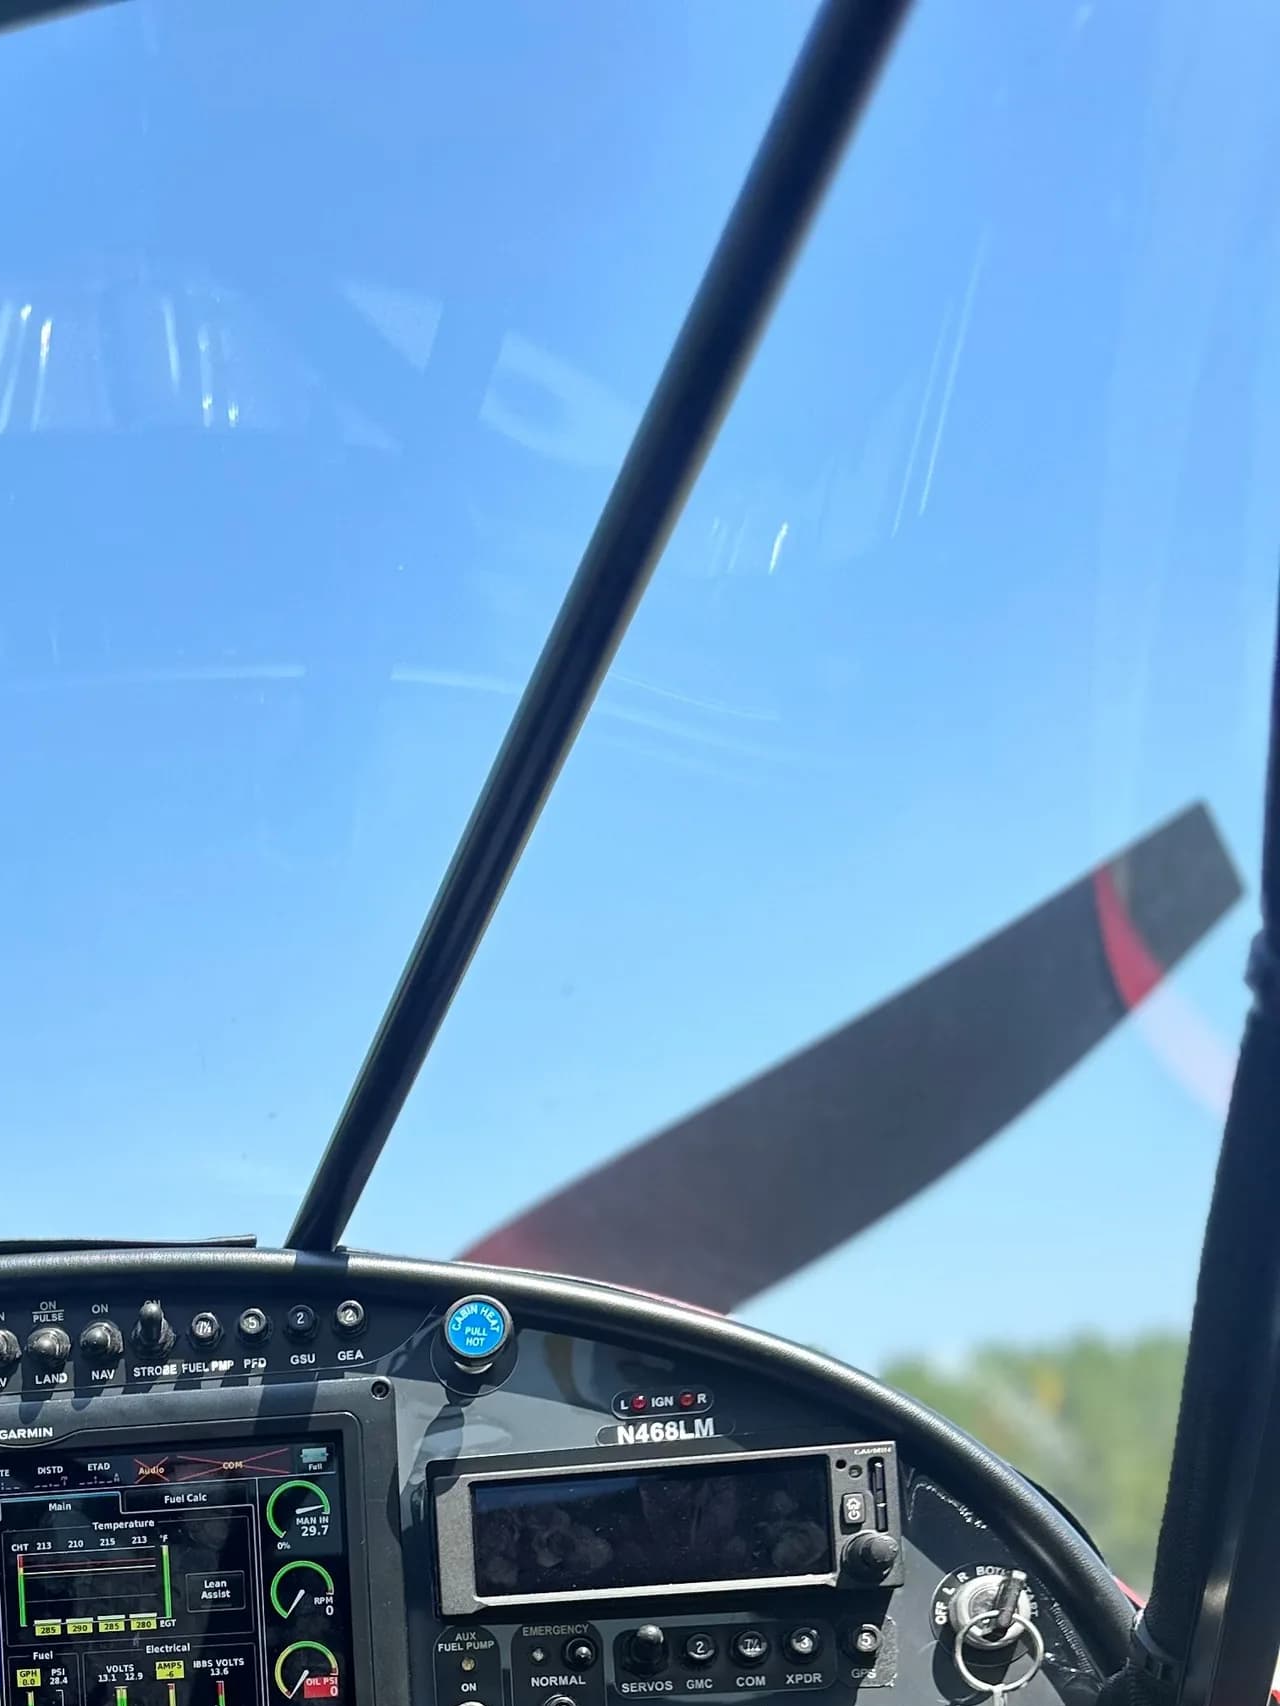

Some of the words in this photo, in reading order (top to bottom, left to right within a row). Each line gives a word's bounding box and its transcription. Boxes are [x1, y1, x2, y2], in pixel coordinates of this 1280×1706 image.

[40, 1300, 56, 1311] ON
[92, 1304, 109, 1314] ON
[32, 1313, 65, 1323] PULSE
[297, 1312, 305, 1324] 2
[451, 1304, 478, 1331] CABIN
[480, 1306, 500, 1333] HEAT
[465, 1327, 488, 1336] PULL
[466, 1337, 485, 1346] HOT
[290, 1353, 316, 1365] GSU
[338, 1349, 364, 1361] GEA
[182, 1362, 209, 1373] FUEL
[211, 1360, 234, 1372] PMP
[244, 1358, 266, 1368] PFD
[92, 1369, 115, 1380] NAV
[133, 1364, 177, 1377] STROBE
[35, 1372, 67, 1385] LAND
[617, 1418, 714, 1444] N468LM
[38, 1466, 63, 1474] DISTD
[88, 1463, 110, 1471] ETAD
[223, 1461, 243, 1469] COM
[164, 1495, 184, 1504] Fuel
[187, 1493, 207, 1502] Calc
[49, 1502, 71, 1511] Main
[92, 1518, 155, 1531] Temperature
[301, 1525, 328, 1536] 29.7
[11, 1543, 29, 1551] CHT
[37, 1542, 52, 1550] 213
[68, 1540, 84, 1548] 210
[100, 1538, 115, 1546] 215
[132, 1536, 147, 1544] 213
[204, 1580, 227, 1588] Lean
[201, 1590, 230, 1599] Assist
[314, 1597, 333, 1605] RPM
[935, 1602, 948, 1624] OFF
[160, 1620, 176, 1628] EGT
[522, 1624, 589, 1636] EMERGENCY
[455, 1632, 476, 1641] AUX
[146, 1643, 190, 1653] Electrical
[438, 1643, 463, 1652] FUEL
[466, 1641, 494, 1650] PUMP
[33, 1652, 53, 1661] Fuel
[157, 1662, 182, 1670] AMPS
[193, 1660, 212, 1668] IBBS
[216, 1658, 244, 1667] VOLTS
[51, 1668, 65, 1677] PSI
[106, 1665, 134, 1673] VOLTS
[210, 1668, 229, 1676] 13.6
[851, 1668, 877, 1679] GPS
[50, 1677, 68, 1685] 28.4
[125, 1673, 143, 1681] 12.9
[531, 1676, 586, 1687] NORMAL
[736, 1676, 766, 1687] COM
[786, 1673, 822, 1684] XPDR
[461, 1683, 477, 1692] ON
[621, 1680, 673, 1693] SERVOS
[686, 1679, 713, 1690] GMC
